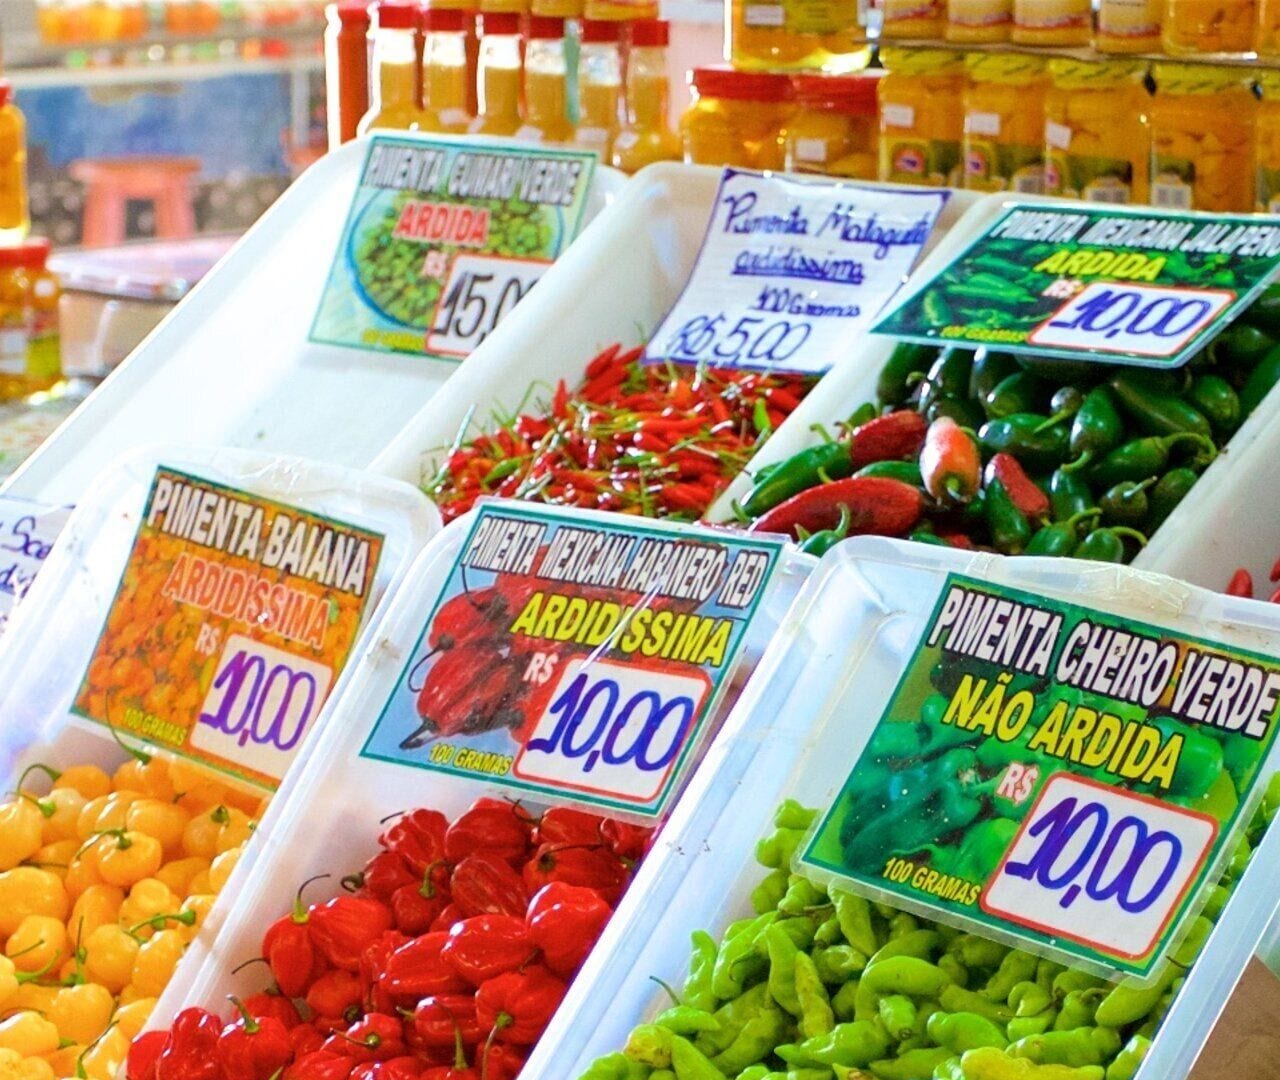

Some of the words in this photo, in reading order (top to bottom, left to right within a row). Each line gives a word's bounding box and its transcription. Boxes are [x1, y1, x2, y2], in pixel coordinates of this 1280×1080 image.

[366, 145, 445, 192] PIMENTA
[520, 158, 583, 205] VERDE
[393, 201, 489, 247] ARDIDA
[990, 209, 1089, 243] PIMENTA
[1078, 216, 1195, 250] MEXICANA
[1033, 250, 1167, 281] ARDIDA
[433, 271, 538, 348] 15,0
[1049, 290, 1212, 338] 10,00
[713, 317, 812, 365] 5,00
[147, 479, 264, 560] PIMENTA
[262, 514, 370, 595] BAIANA
[463, 516, 547, 574] PIMENTA
[539, 525, 640, 588] MEXICANA
[629, 536, 730, 601] HABANERO
[724, 550, 769, 609] RED
[162, 552, 330, 650] ARDIDISSIMA
[510, 592, 733, 666] ARDIDISSIMA
[195, 622, 220, 656] R$
[523, 651, 557, 683] R$
[927, 587, 1062, 676] PIMENTA
[1056, 620, 1178, 707] CHEIRO
[199, 650, 317, 751] 10,00
[526, 673, 695, 772] 10,00
[429, 744, 453, 763] 100
[453, 749, 514, 776] GRAMAS
[943, 672, 1034, 743] NÃO
[1028, 701, 1183, 790] ARDIDA
[996, 761, 1040, 805] R$
[882, 857, 912, 880] 100
[911, 868, 982, 906] GRAMAS
[1005, 796, 1183, 914] 10,00
